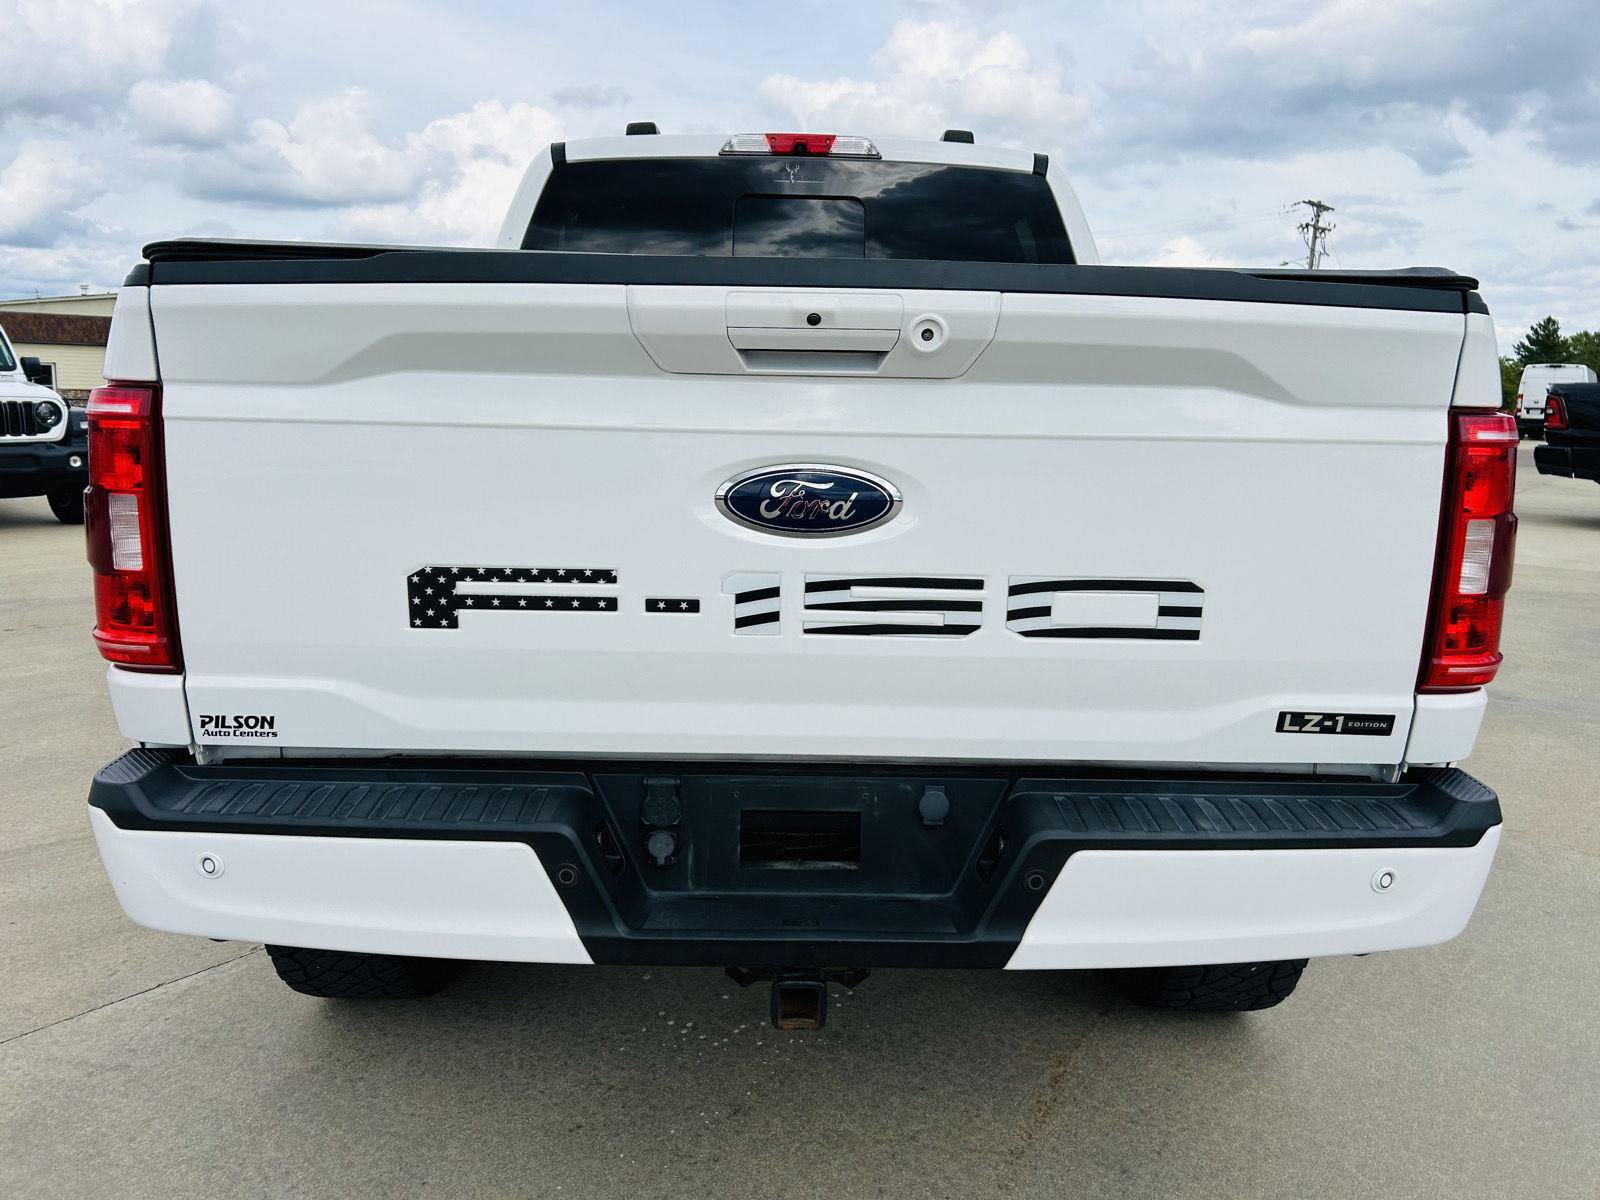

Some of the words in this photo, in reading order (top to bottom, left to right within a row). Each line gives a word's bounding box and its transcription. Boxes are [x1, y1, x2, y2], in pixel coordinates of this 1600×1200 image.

[759, 479, 858, 520] Ford
[407, 566, 1204, 641] F-150
[199, 714, 275, 729] PILSON
[1283, 713, 1344, 732] LZ-1
[1347, 720, 1387, 728] EDITION
[202, 728, 231, 737] Auto
[233, 729, 278, 737] Centers
